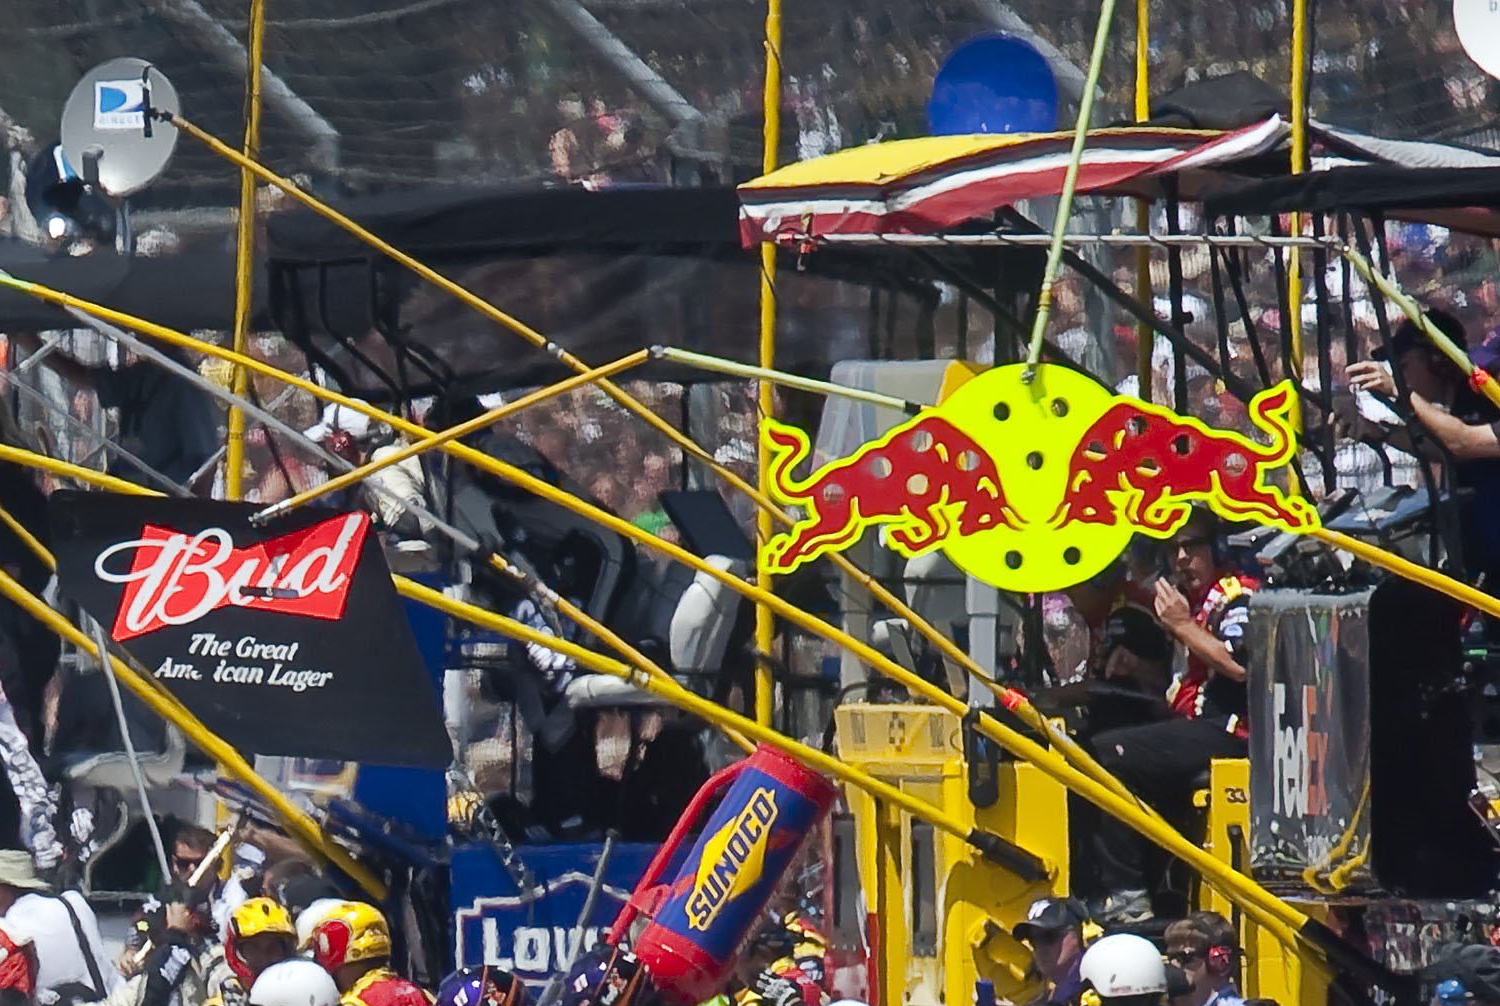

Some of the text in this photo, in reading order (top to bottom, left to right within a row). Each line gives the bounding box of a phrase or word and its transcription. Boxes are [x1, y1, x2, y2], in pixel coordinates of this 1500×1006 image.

[94, 512, 364, 626] Bud
[154, 657, 334, 692] Amican Lager
[188, 632, 299, 662] The Great
[691, 793, 775, 926] SUNOCO
